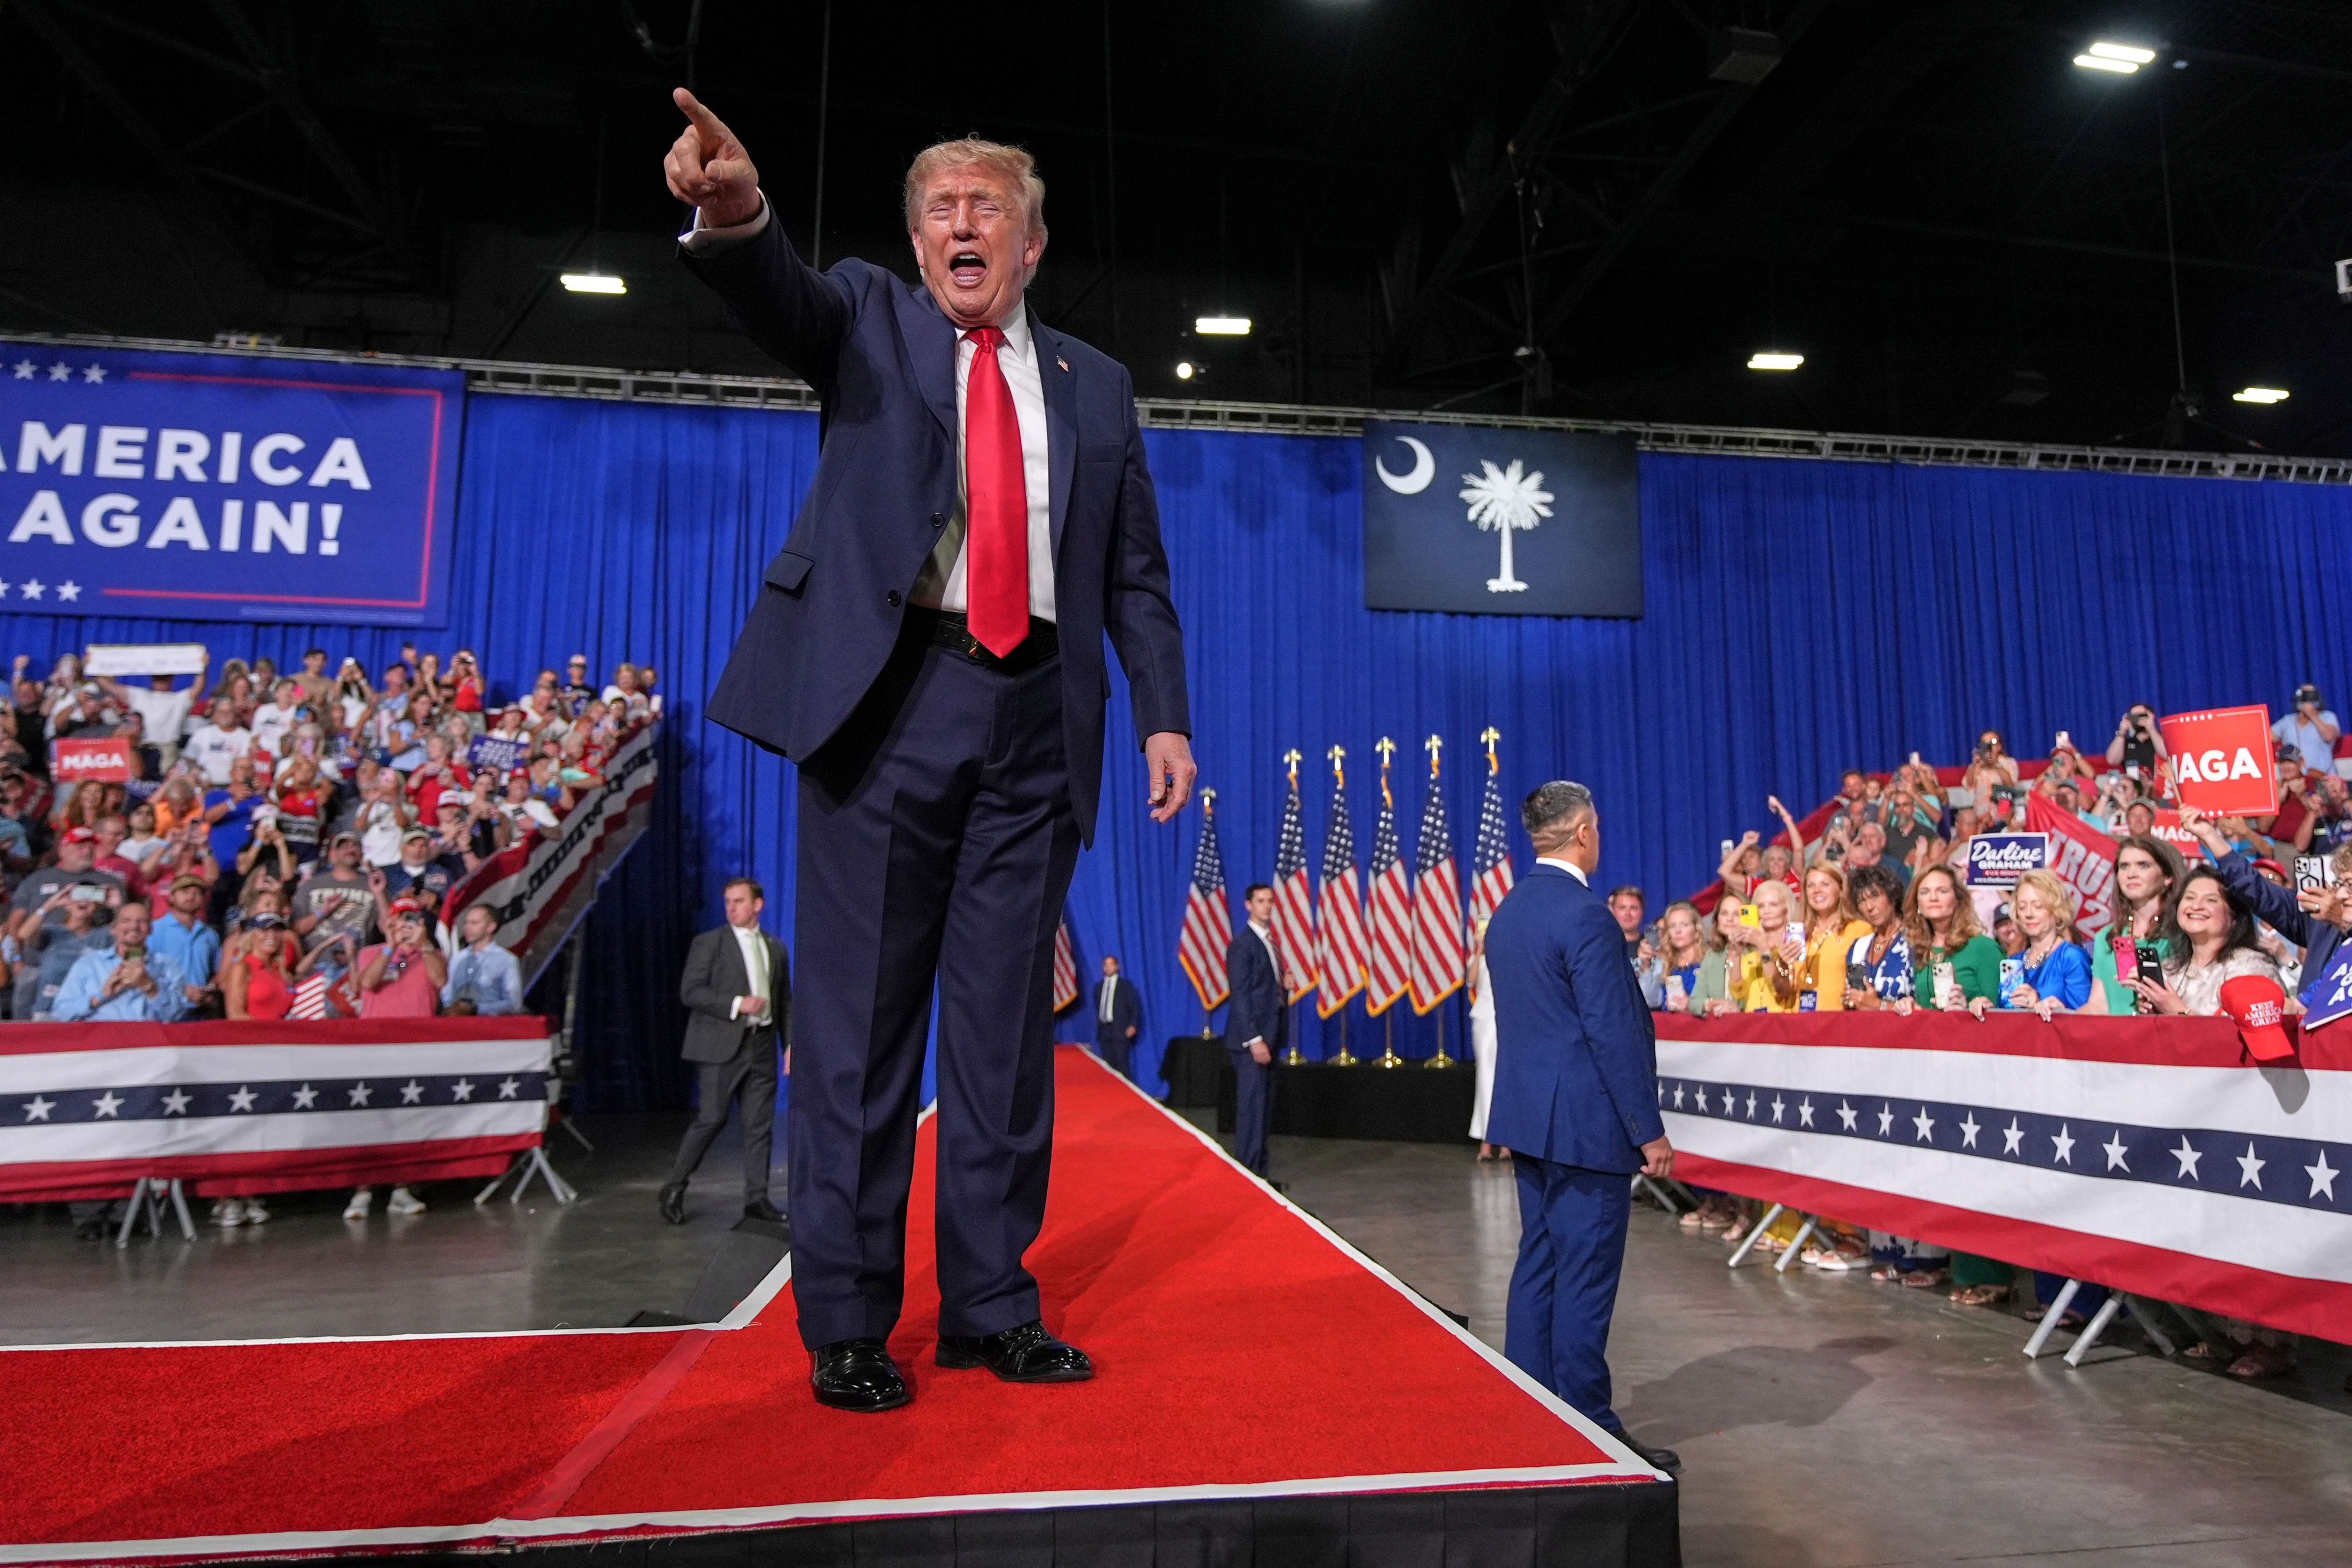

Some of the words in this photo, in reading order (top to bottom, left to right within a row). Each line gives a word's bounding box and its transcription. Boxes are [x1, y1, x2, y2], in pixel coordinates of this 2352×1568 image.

[0, 420, 372, 490] MERICA
[8, 489, 343, 556] AGAIN!
[62, 752, 125, 770] MAGA
[2150, 825, 2199, 842] MAG
[1971, 841, 2042, 862] Darline
[1978, 860, 2033, 870] GRAHAM
